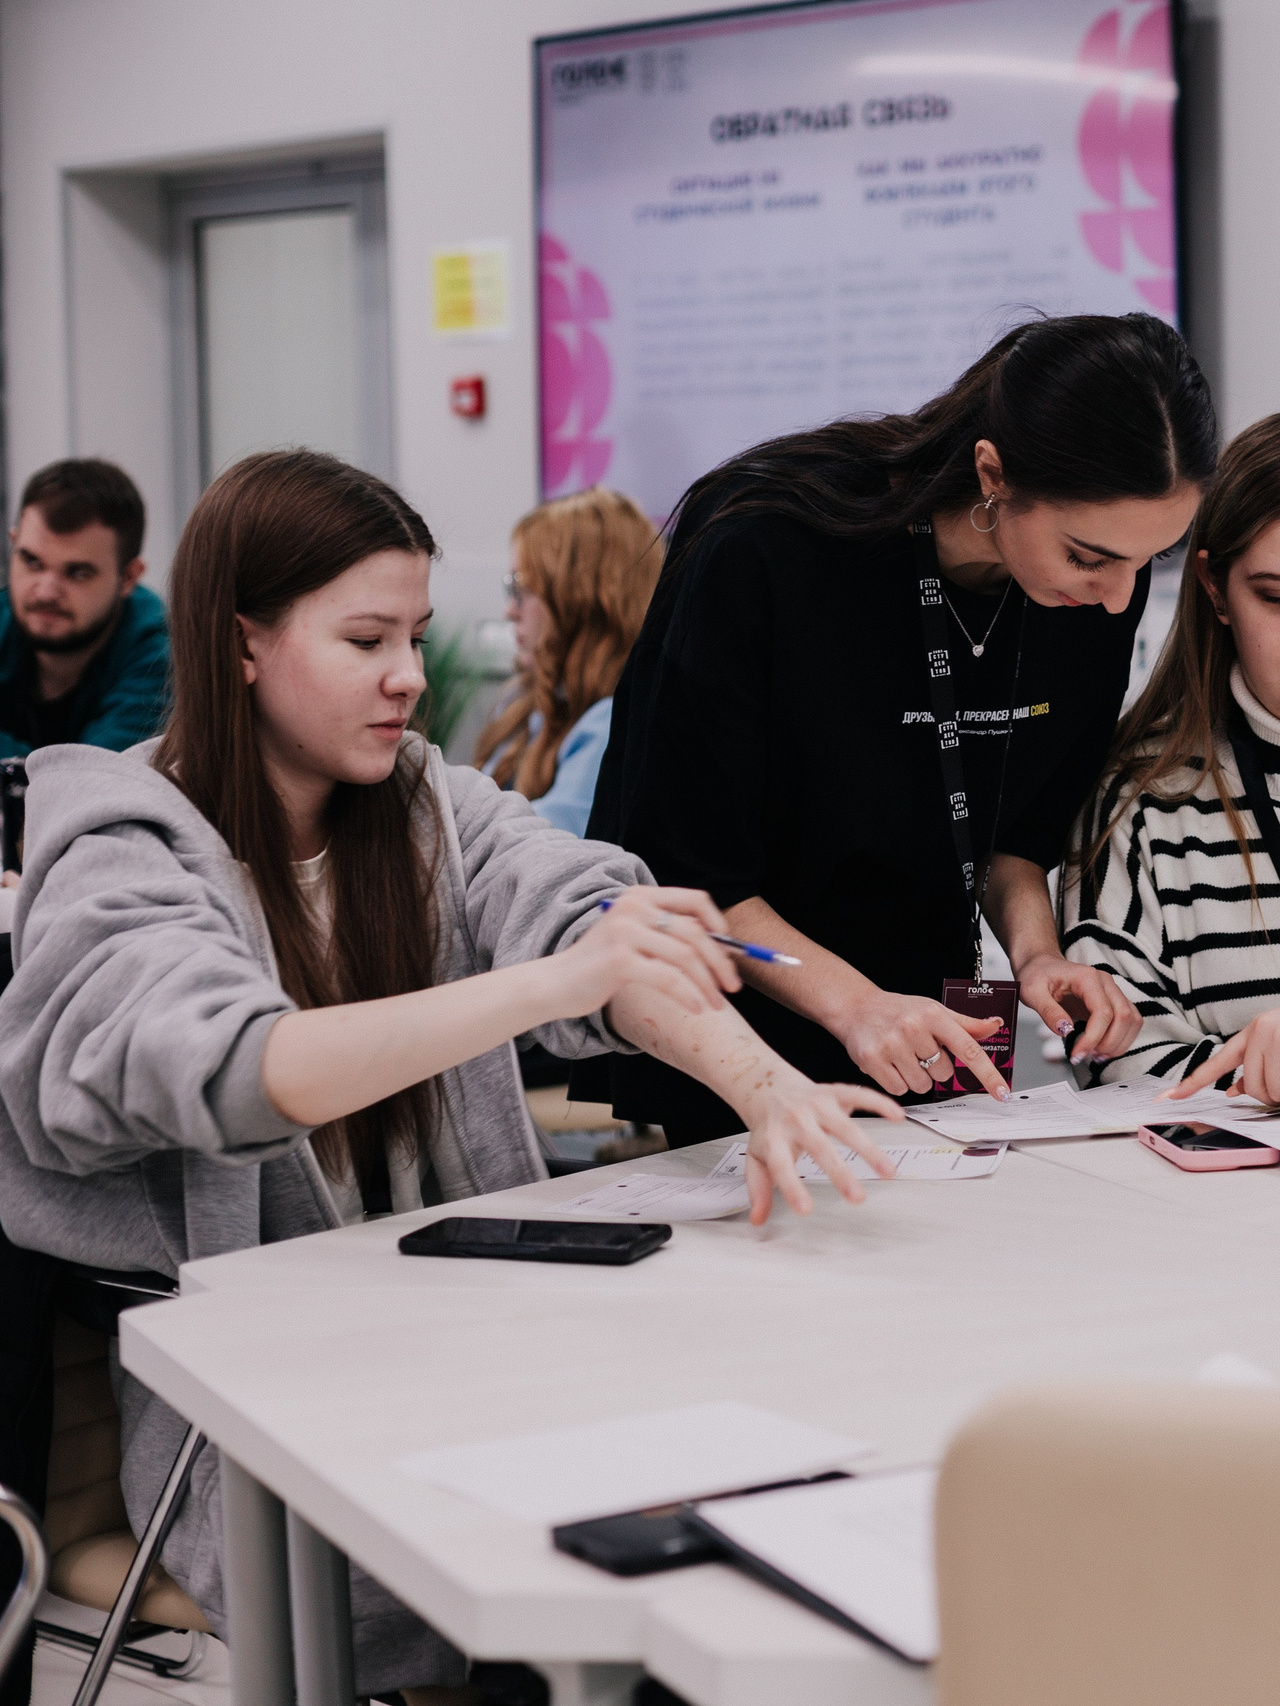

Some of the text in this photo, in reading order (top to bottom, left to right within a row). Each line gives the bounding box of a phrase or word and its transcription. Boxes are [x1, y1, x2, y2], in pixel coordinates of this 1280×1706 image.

[709, 94, 950, 143] ОБРАТНАЯ СВЯЗЬ
[902, 711, 936, 724] ДРУЗЬ
[1012, 706, 1030, 720] НАШ
[1030, 702, 1049, 716] СОЮЗ
